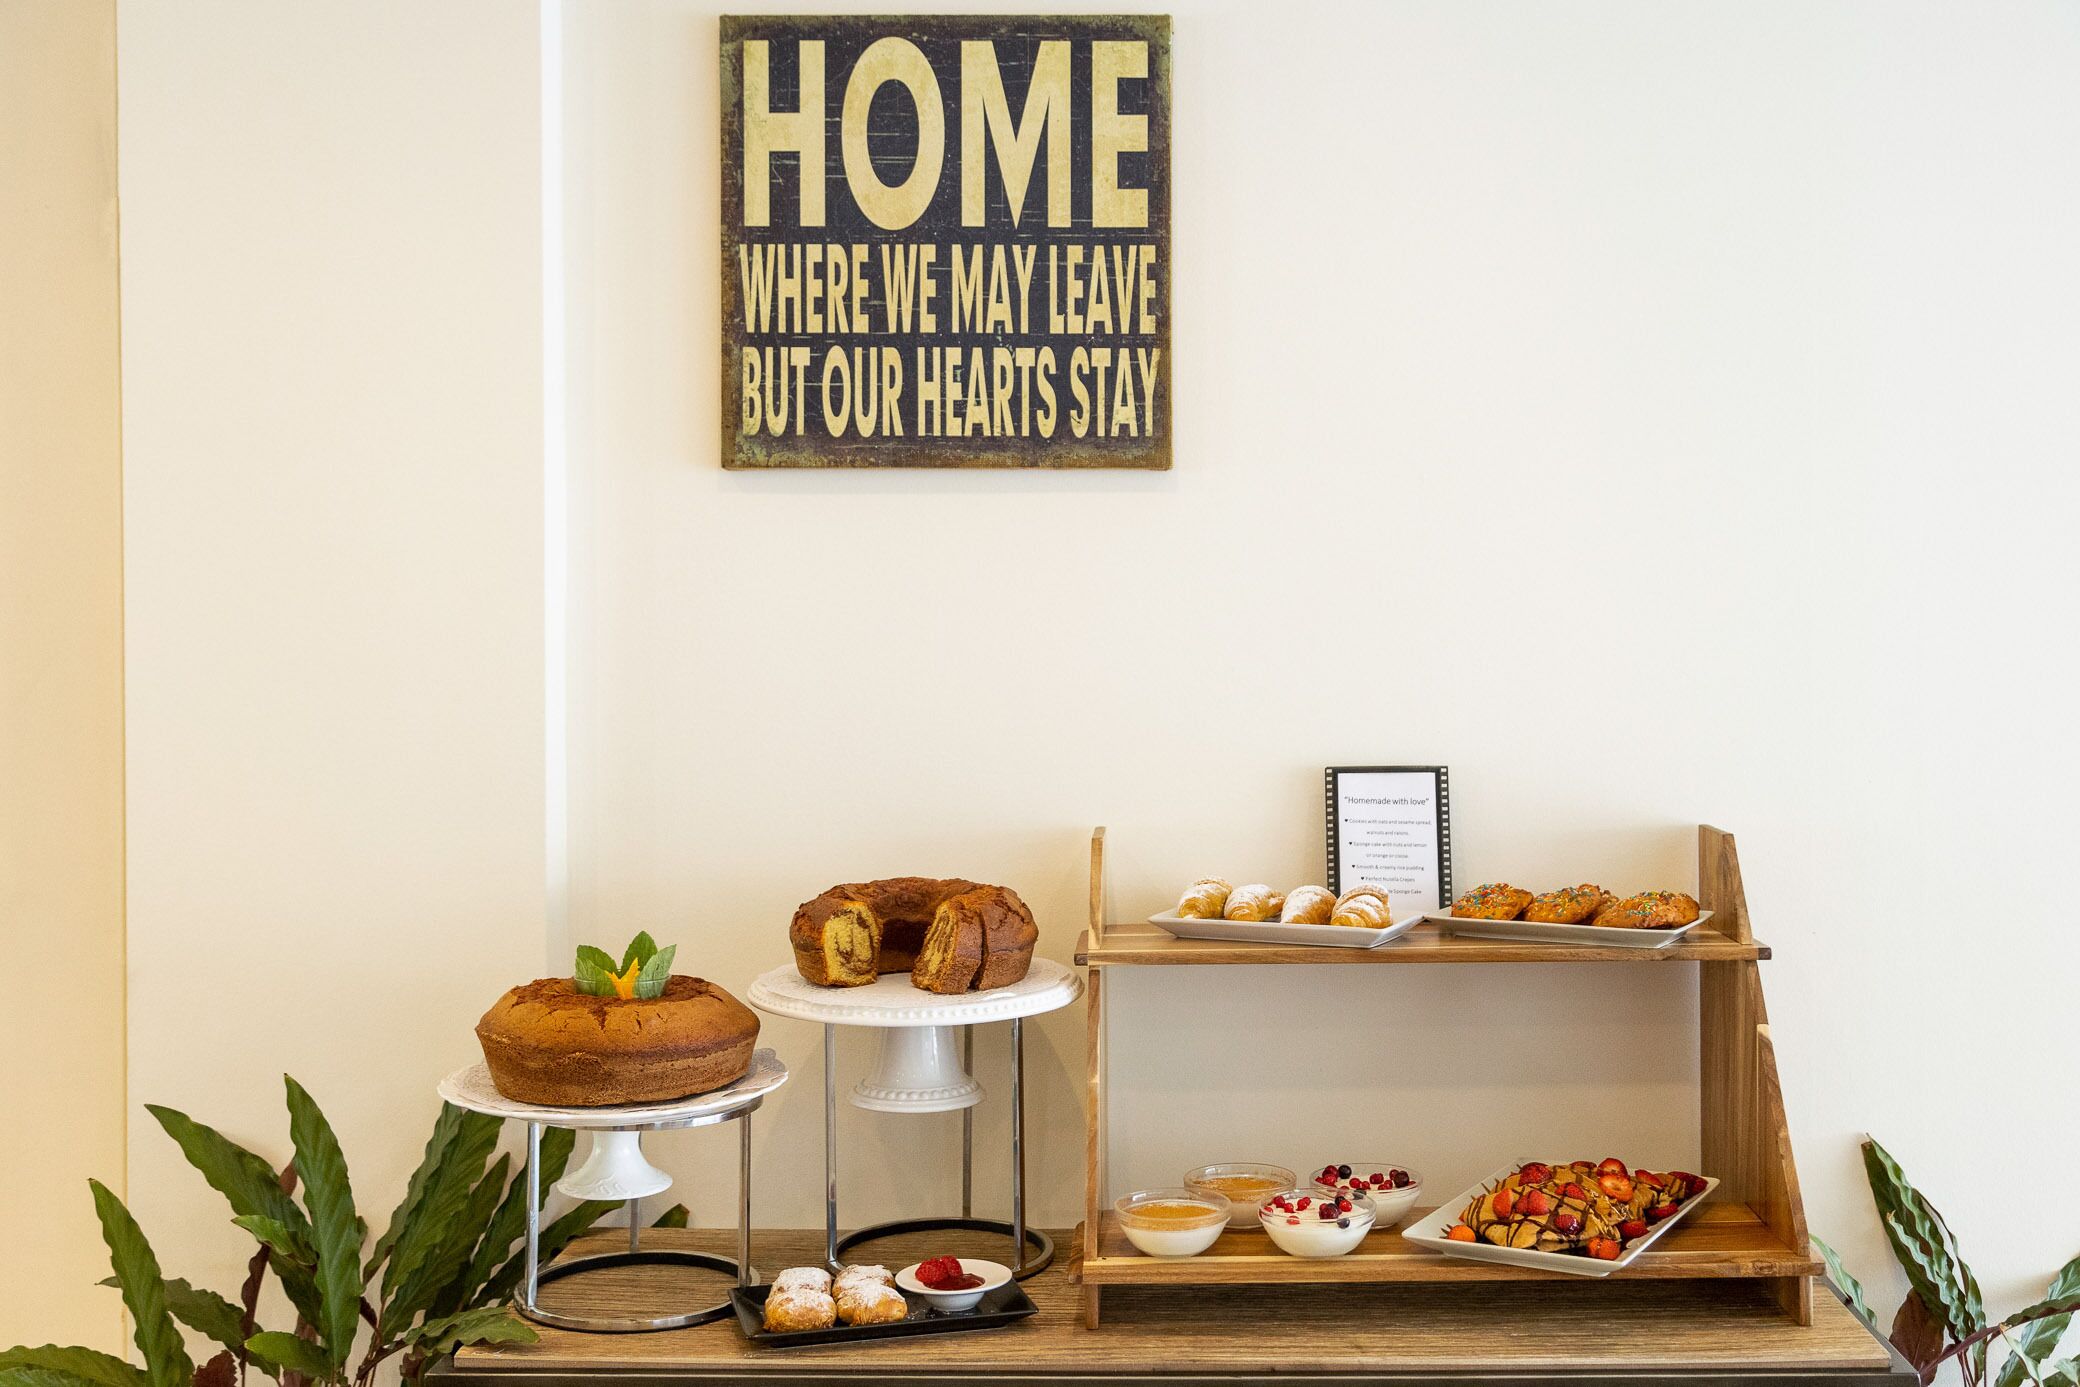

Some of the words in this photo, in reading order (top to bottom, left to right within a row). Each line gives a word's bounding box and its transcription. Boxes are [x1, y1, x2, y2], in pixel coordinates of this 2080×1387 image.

[743, 37, 1148, 229] HOME
[740, 244, 869, 333] WHERE
[881, 244, 937, 333] WE
[952, 244, 1036, 334] MAY
[1049, 245, 1156, 334] LEAVE
[743, 346, 811, 436] BUT
[822, 345, 904, 437] OUR
[917, 346, 1057, 437] HEARTS
[1070, 346, 1160, 437] STAY
[1392, 797, 1409, 805] with
